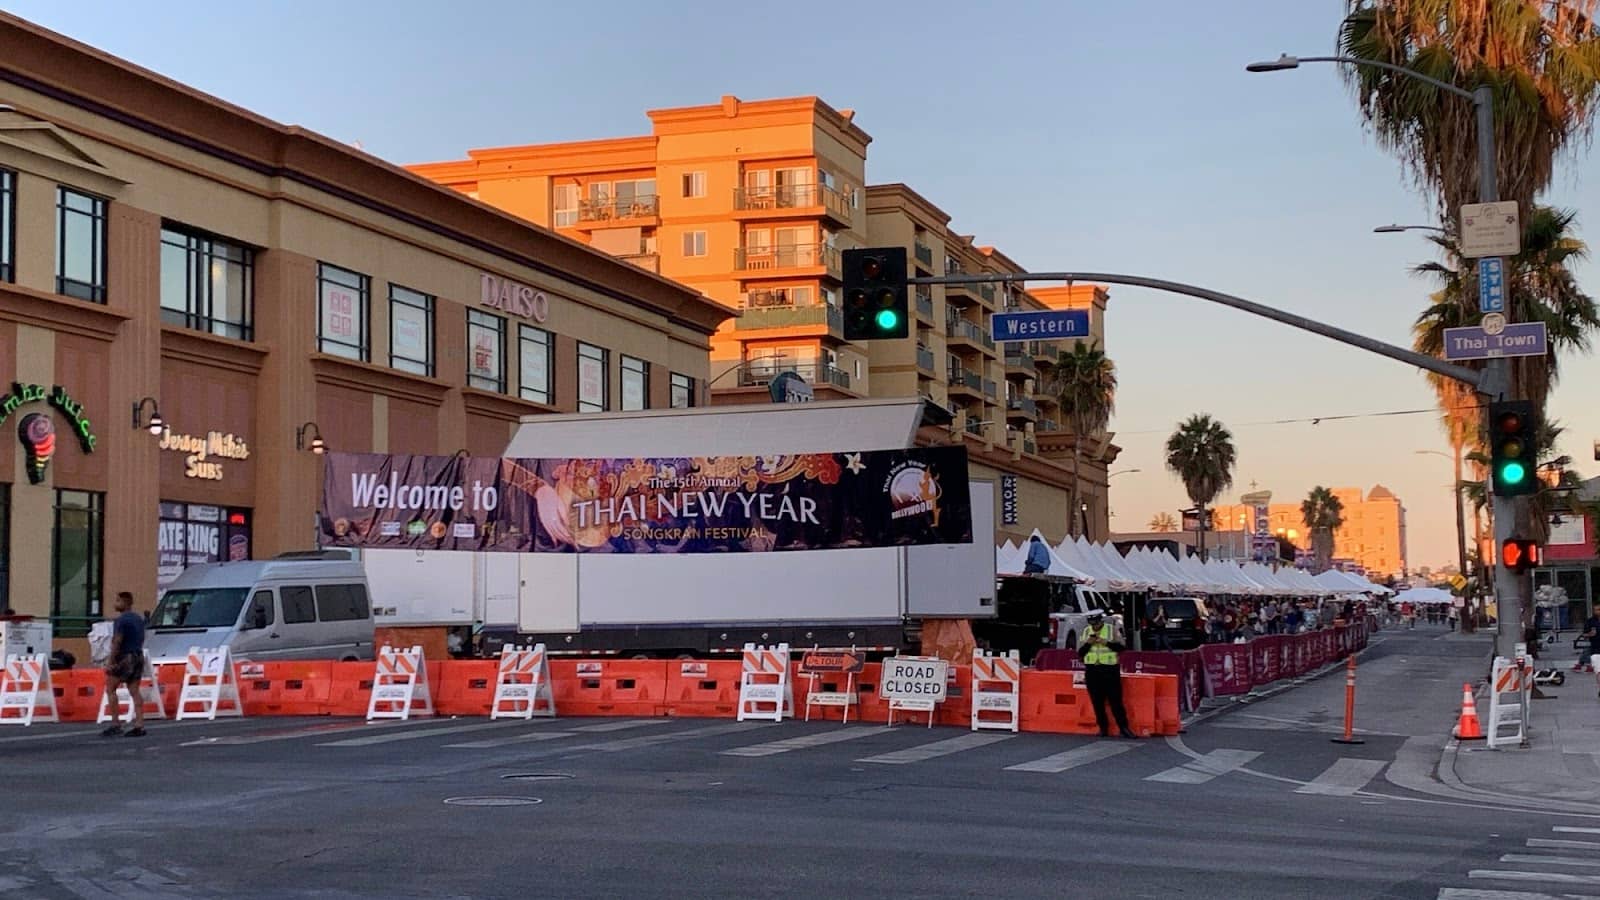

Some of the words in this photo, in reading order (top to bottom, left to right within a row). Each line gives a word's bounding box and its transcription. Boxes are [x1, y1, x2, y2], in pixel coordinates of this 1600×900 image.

[480, 272, 549, 323] DAISO
[1007, 319, 1074, 334] Western
[1454, 335, 1488, 350] Thai
[1495, 334, 1536, 347] Town
[160, 424, 207, 461] Jersey
[648, 477, 671, 489] The
[673, 475, 697, 488] 15th
[699, 476, 740, 487] Annual
[351, 471, 465, 511] Welcome
[472, 480, 498, 511] to
[1003, 477, 1013, 522] ROSS
[573, 494, 646, 527] THAI
[657, 491, 729, 519] NEW
[623, 526, 700, 540] SONGKRAN
[704, 527, 767, 539] FESTIVAL
[895, 666, 935, 679] ROAD
[886, 680, 941, 695] CLOSED
